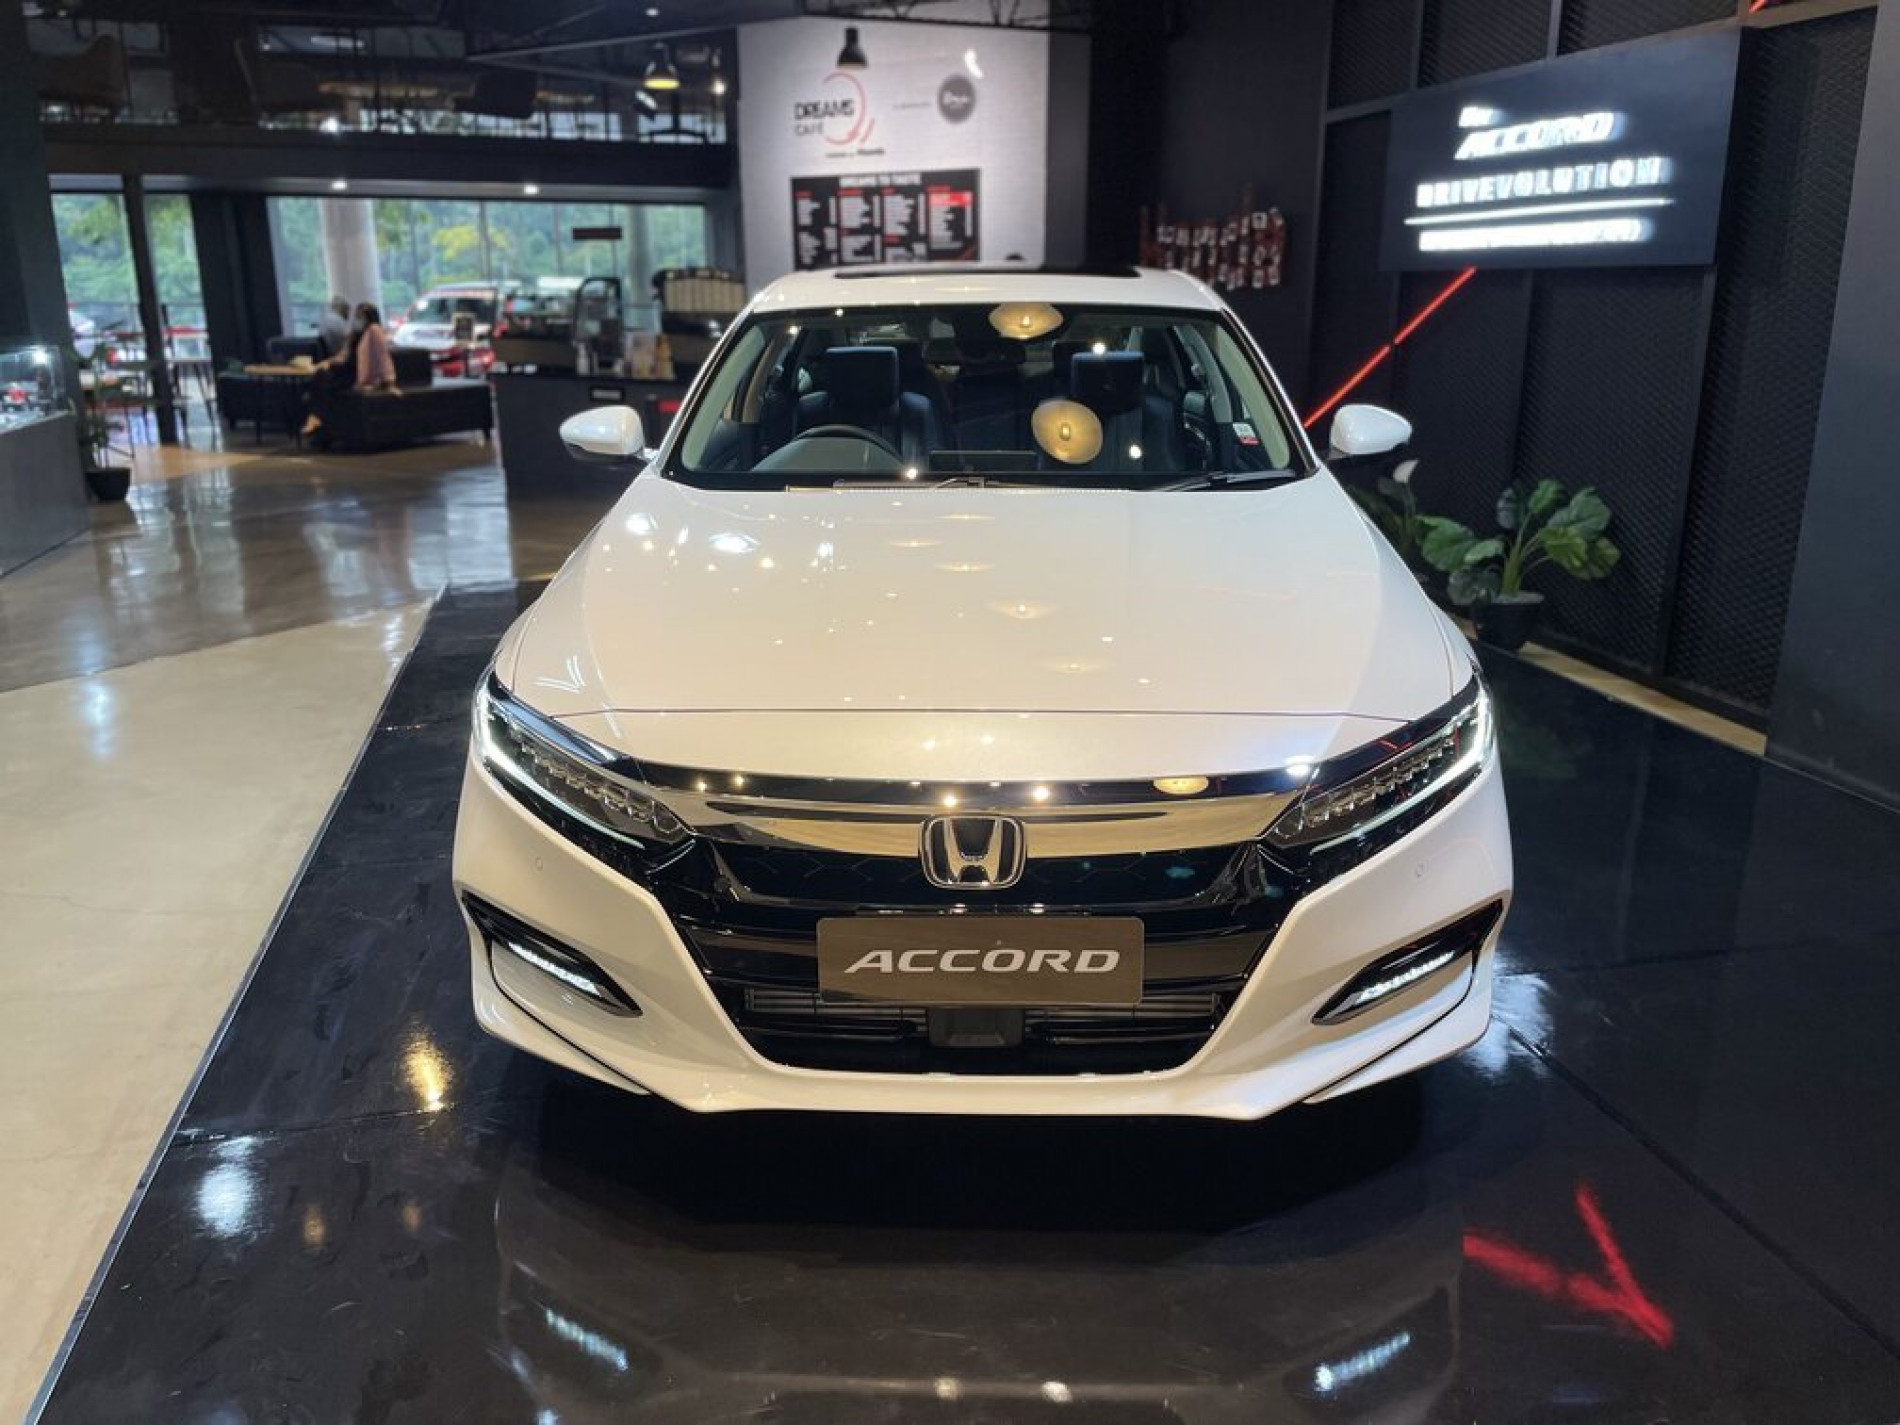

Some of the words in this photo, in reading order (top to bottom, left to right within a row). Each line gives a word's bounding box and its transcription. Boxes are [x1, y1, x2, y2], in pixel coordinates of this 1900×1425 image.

[794, 99, 854, 120] DREAMS
[1454, 110, 1620, 161] ACCORD
[1416, 155, 1667, 208] DRIVEVOLUTION
[844, 949, 1121, 974] ACCORD
